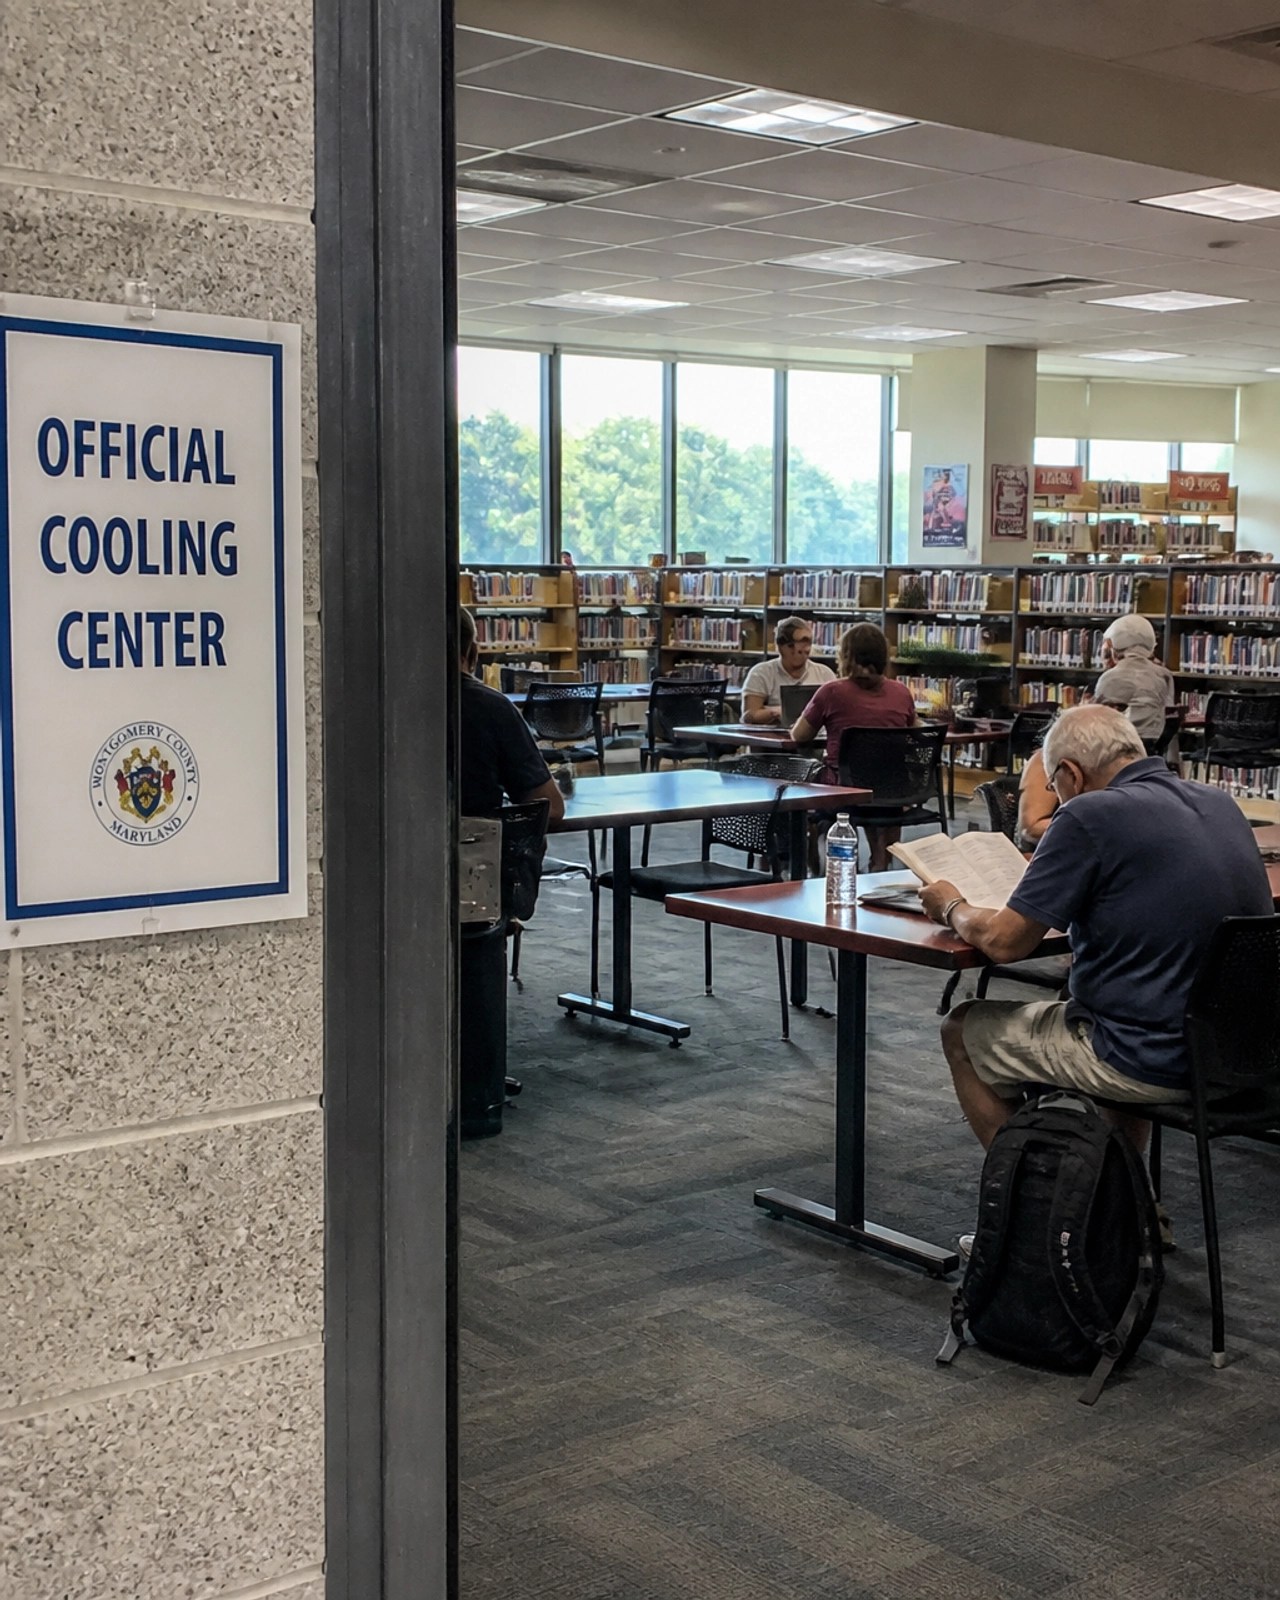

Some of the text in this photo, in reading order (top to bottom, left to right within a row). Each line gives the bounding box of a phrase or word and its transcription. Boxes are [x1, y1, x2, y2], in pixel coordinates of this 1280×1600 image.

[38, 417, 235, 485] OFFICIAL
[41, 514, 237, 577] COOLING
[58, 610, 227, 670] CENTER
[166, 732, 198, 784] COUNTY
[109, 816, 182, 842] MARYLAND
